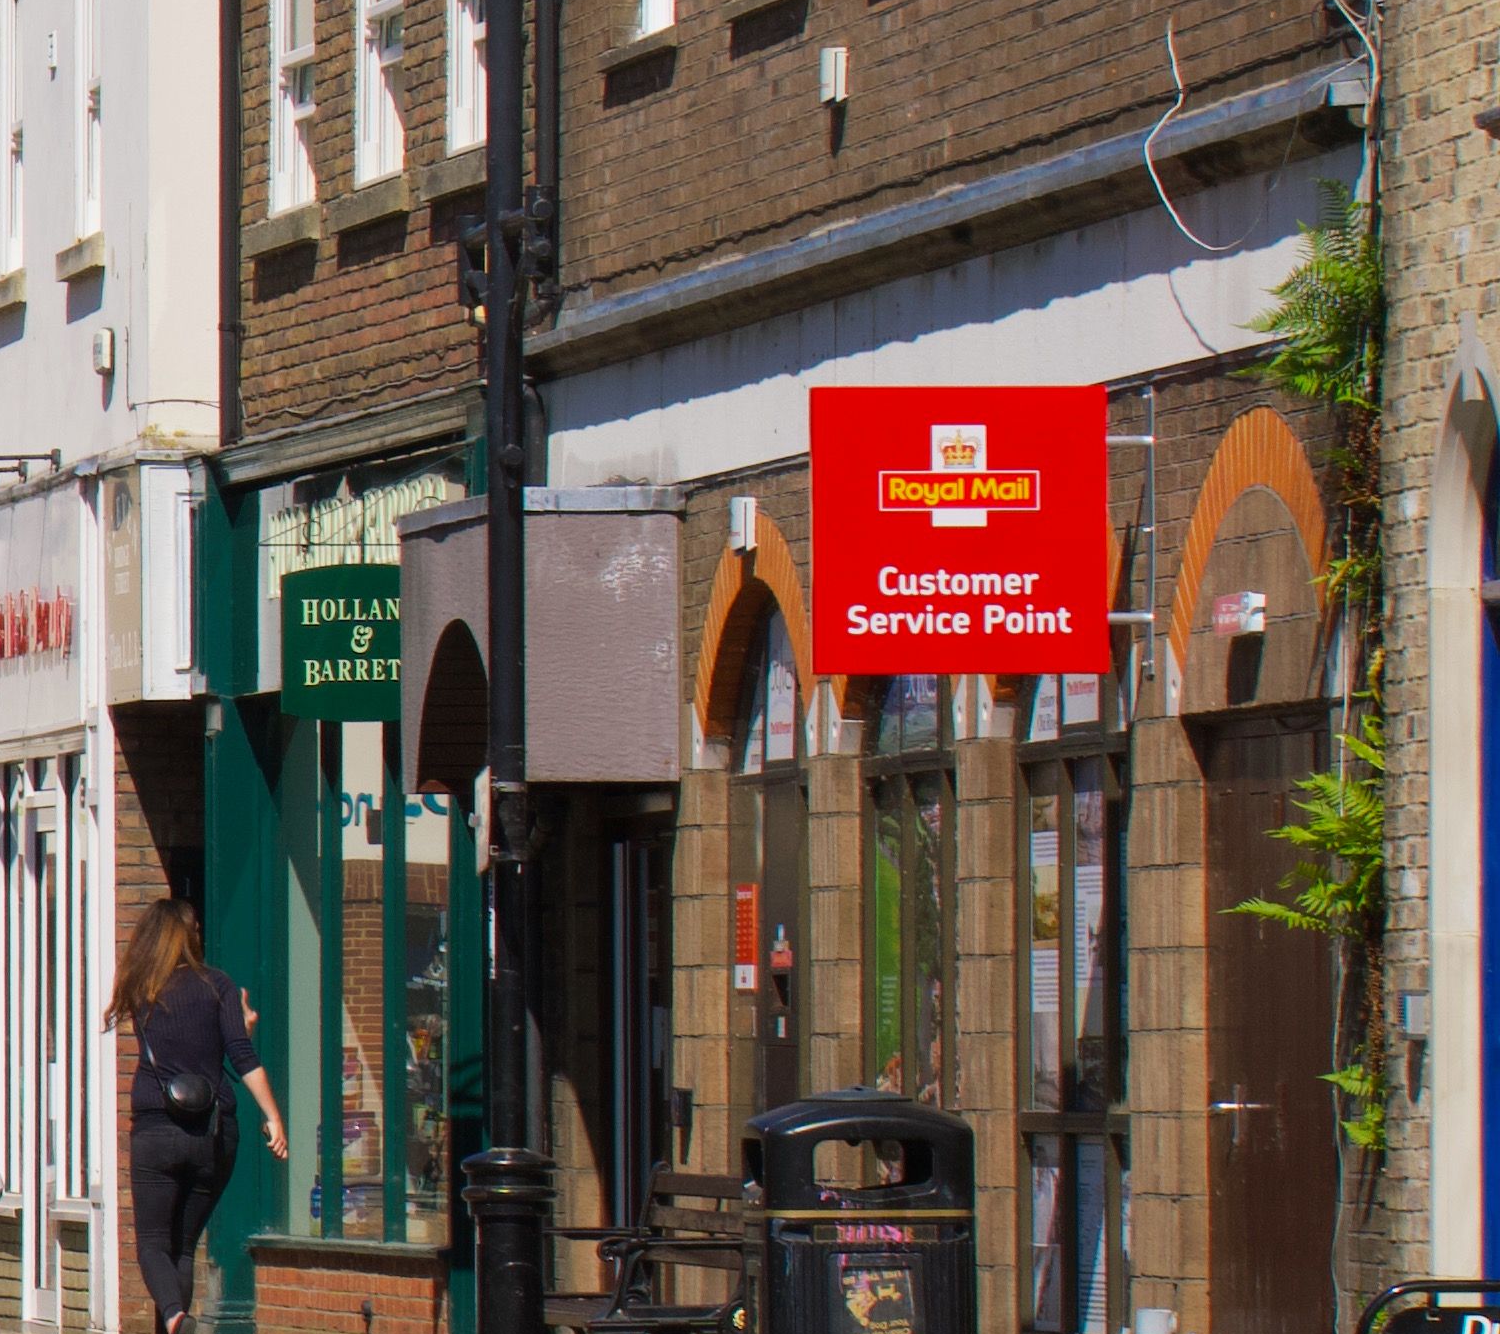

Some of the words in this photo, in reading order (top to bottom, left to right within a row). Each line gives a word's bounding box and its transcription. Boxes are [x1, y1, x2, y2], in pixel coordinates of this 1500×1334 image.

[888, 478, 964, 505] Royal
[970, 477, 1029, 500] Mail
[878, 566, 1040, 596] Customer
[301, 598, 400, 625] HOLLAN
[847, 604, 971, 635] Service
[983, 604, 1073, 635] Point
[350, 624, 373, 654] &
[303, 658, 401, 686] BARRET
